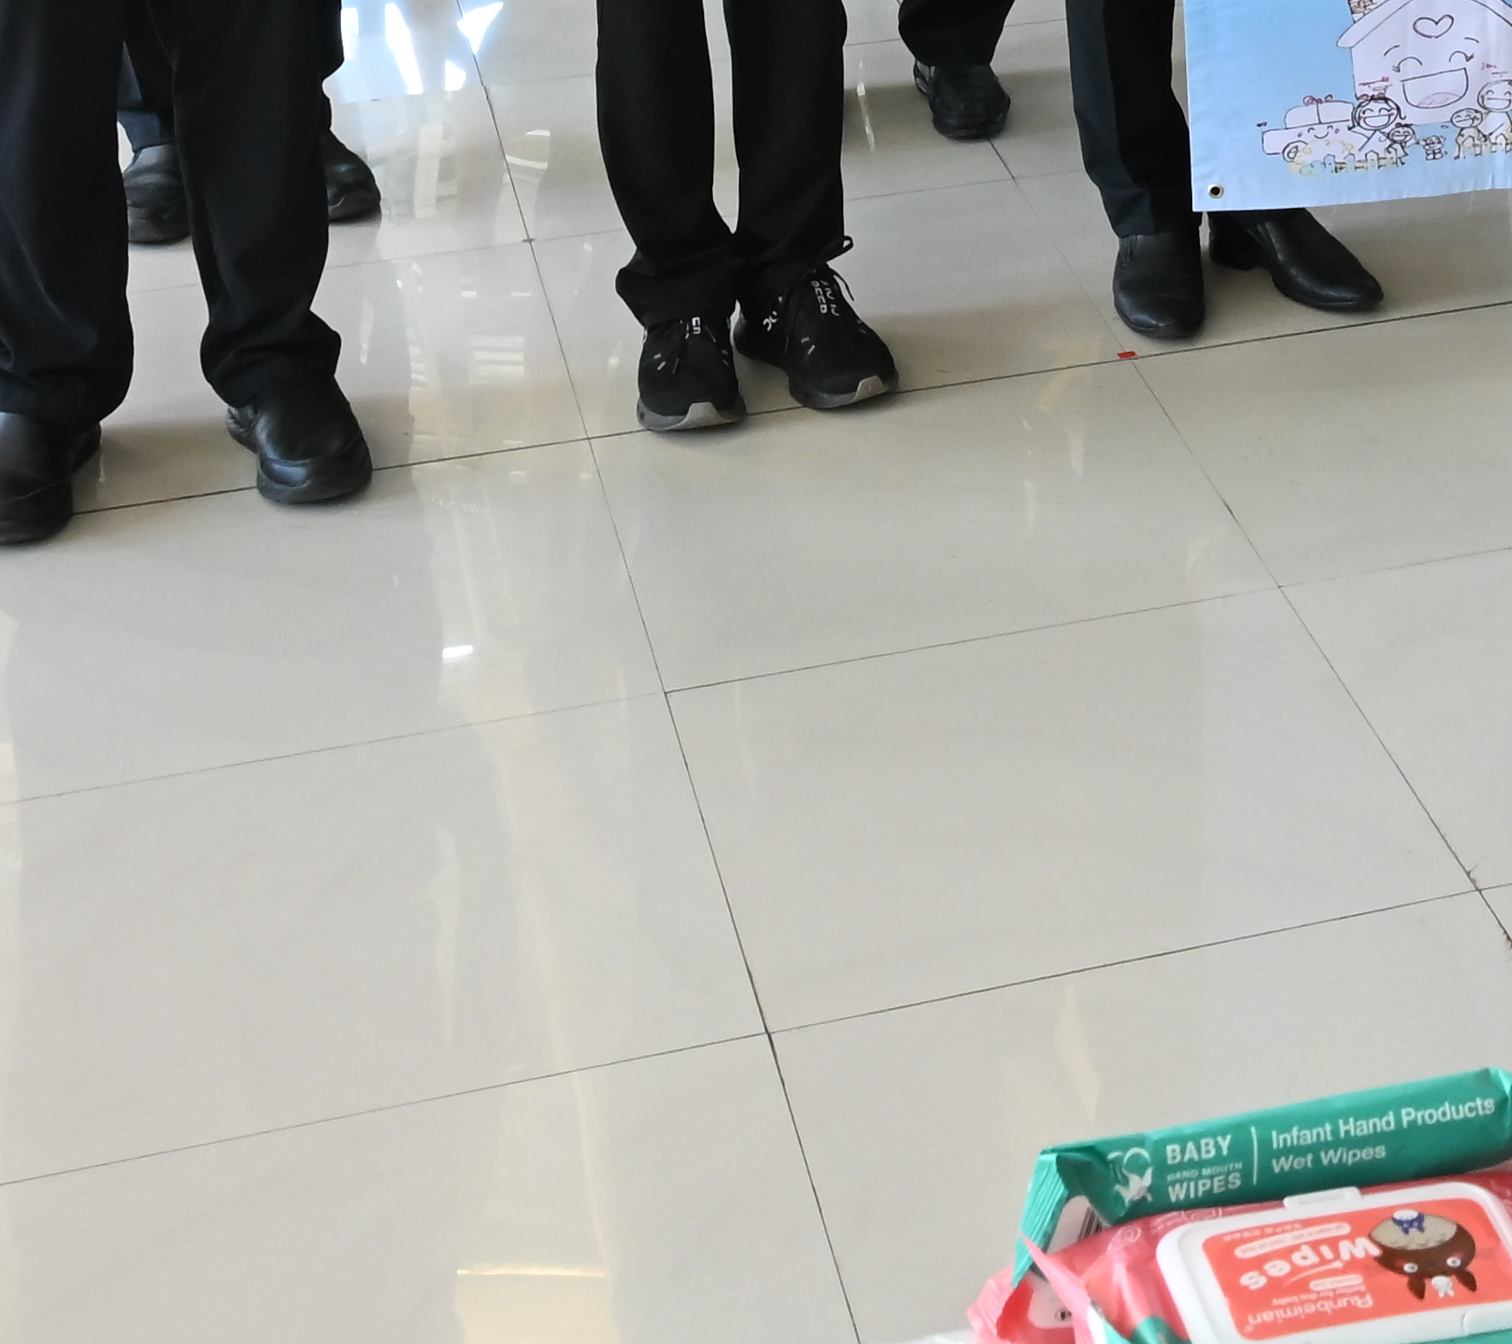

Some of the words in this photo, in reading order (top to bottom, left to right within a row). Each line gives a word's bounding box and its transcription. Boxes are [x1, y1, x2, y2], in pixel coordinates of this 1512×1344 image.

[1272, 1122, 1333, 1150] Infant
[1339, 1110, 1395, 1139] Hand
[1401, 1097, 1495, 1129] Products
[1166, 1135, 1232, 1165] BABY
[1272, 1154, 1313, 1174] Wet
[1321, 1143, 1386, 1167] Wipes
[1168, 1172, 1242, 1203] WIPES
